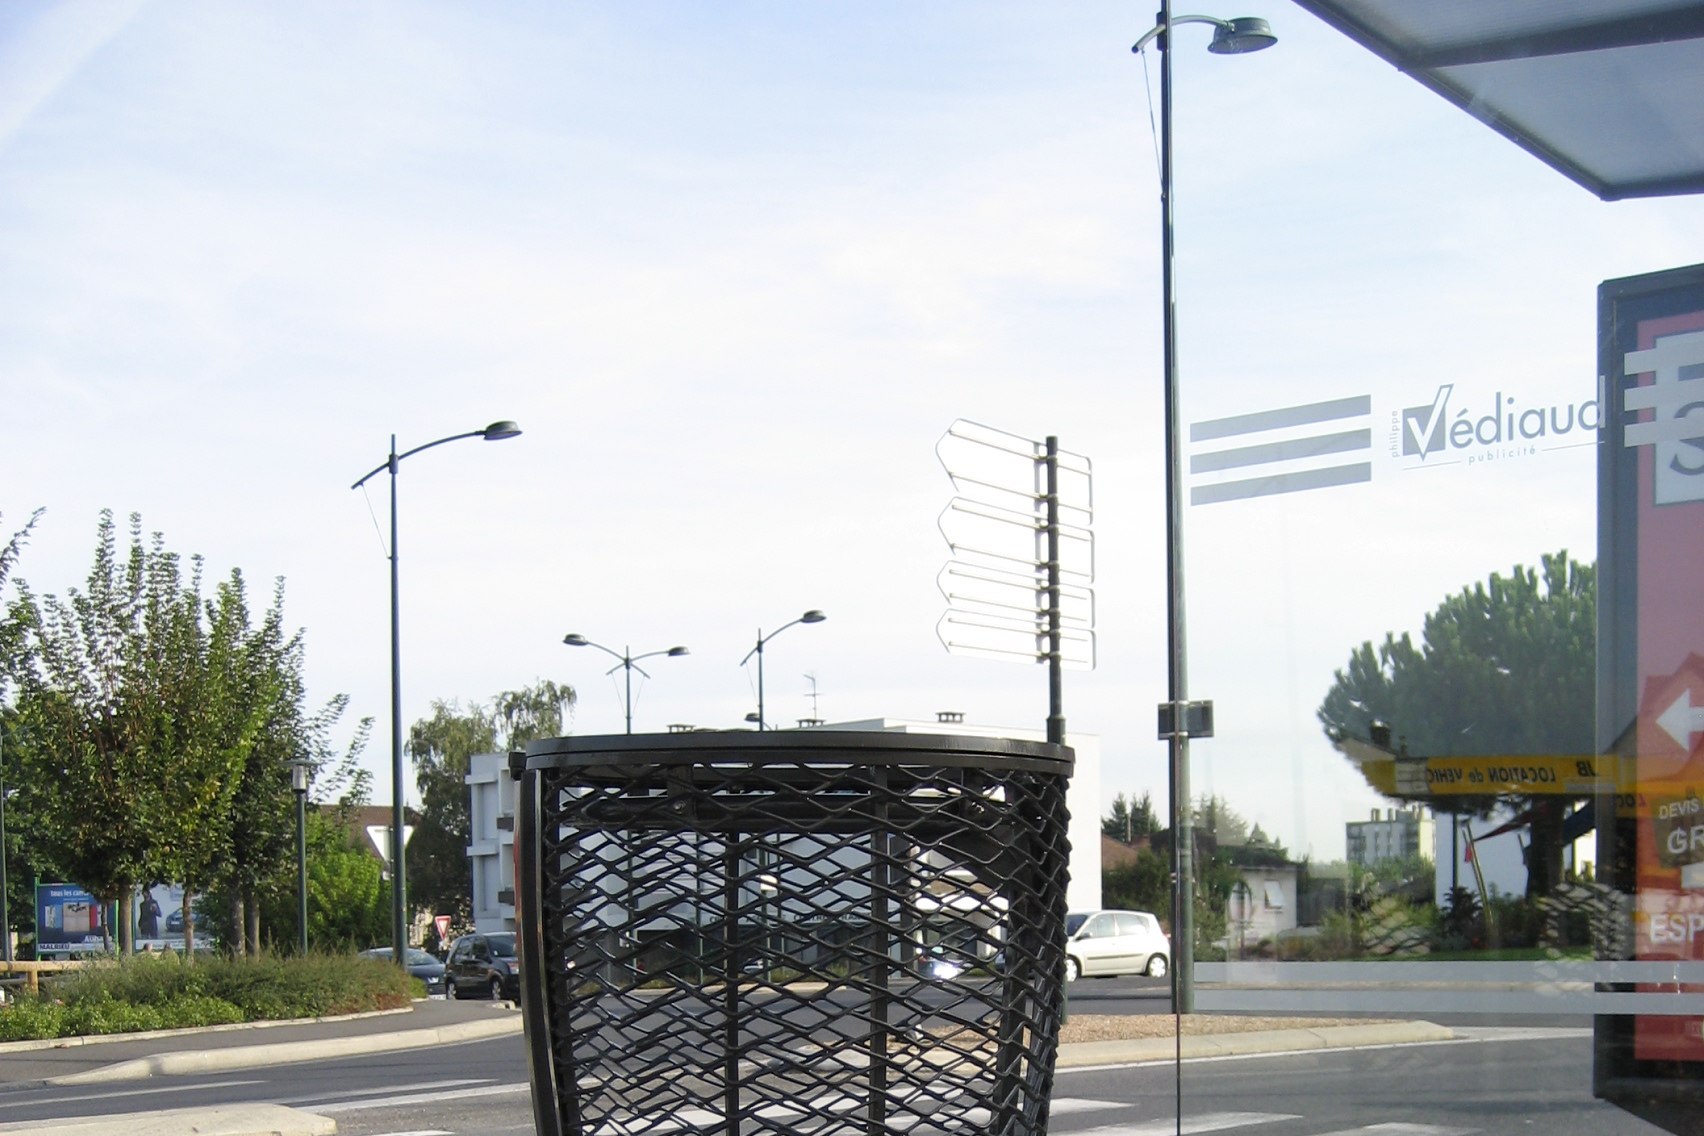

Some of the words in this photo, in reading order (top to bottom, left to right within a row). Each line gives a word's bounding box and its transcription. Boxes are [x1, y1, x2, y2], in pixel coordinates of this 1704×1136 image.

[1389, 410, 1400, 458] philippe
[1402, 383, 1605, 462] Védiaud
[1468, 446, 1536, 465] publicité
[1659, 798, 1699, 819] DEVIS
